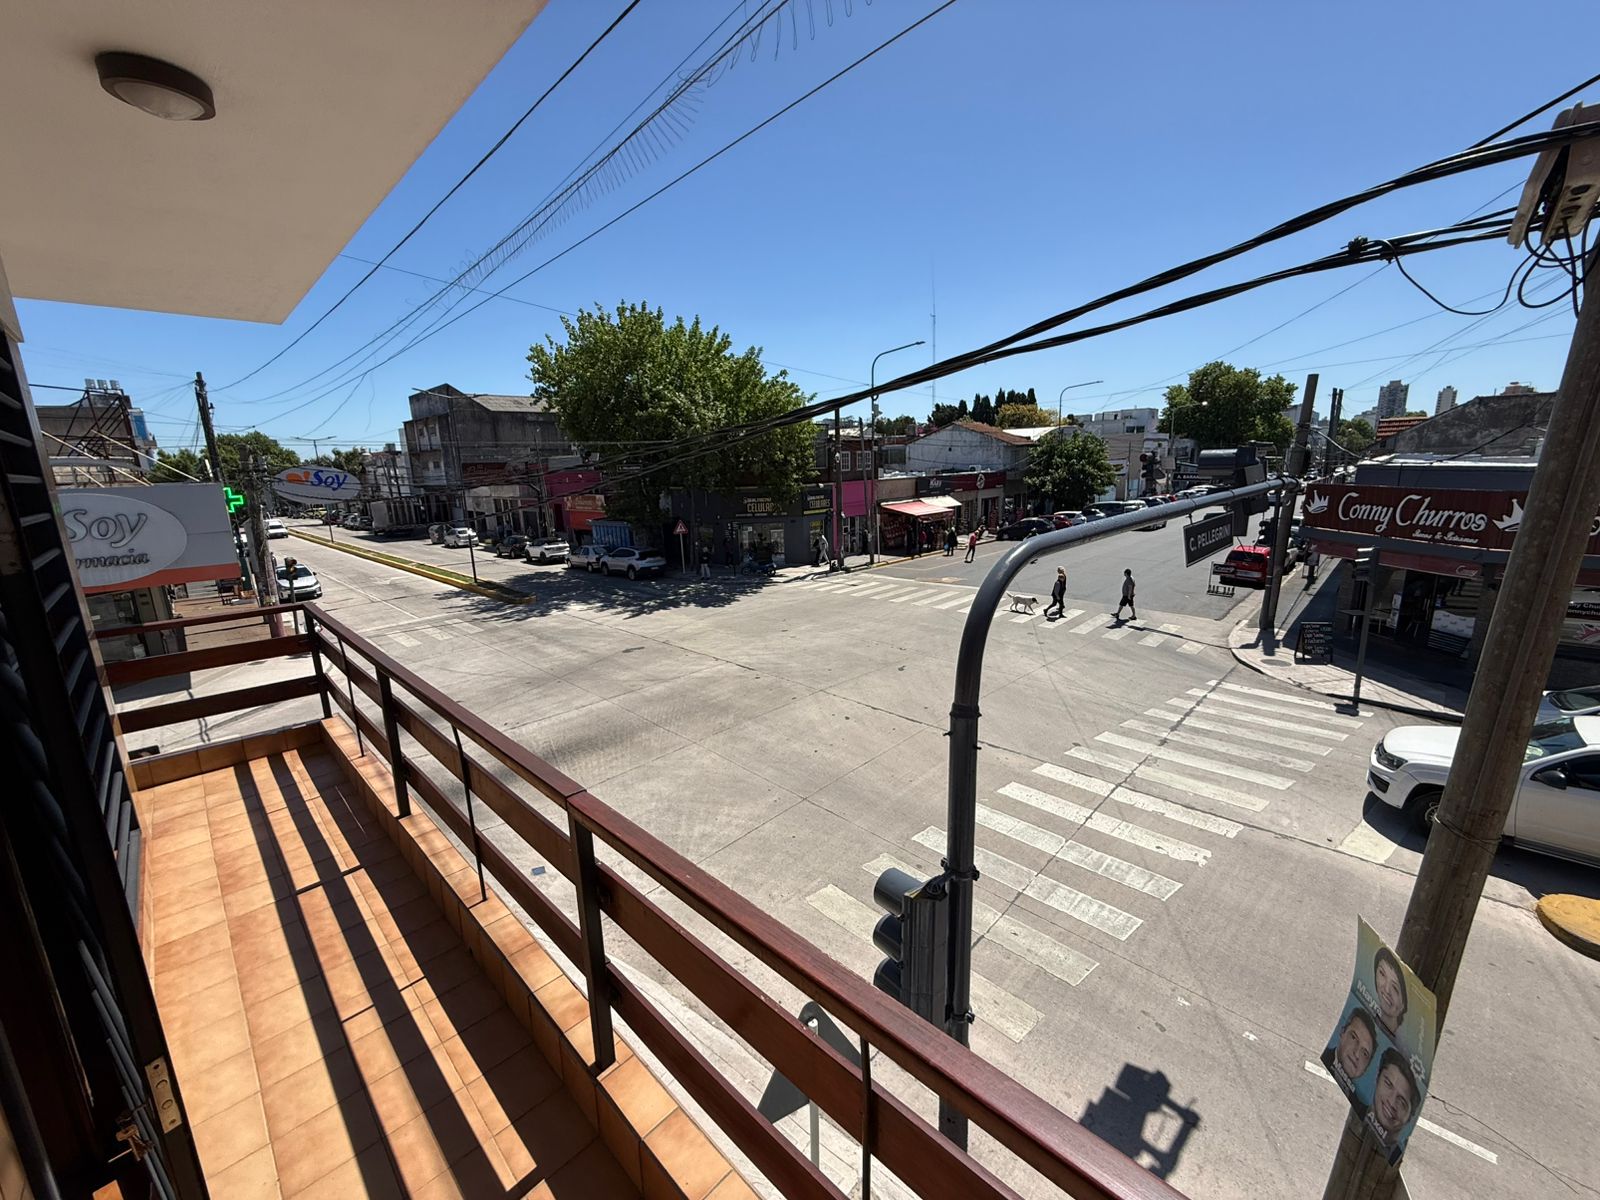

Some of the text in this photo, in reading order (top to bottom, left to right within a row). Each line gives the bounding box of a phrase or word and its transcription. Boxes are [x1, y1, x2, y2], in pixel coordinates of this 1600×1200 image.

[311, 470, 348, 491] Soy
[63, 509, 148, 548] Soy
[1338, 492, 1487, 533] Conny Churros
[1189, 523, 1232, 551] C. PELLEGRINI
[1357, 980, 1382, 1017] Mayra
[1367, 1111, 1388, 1140] Axel
